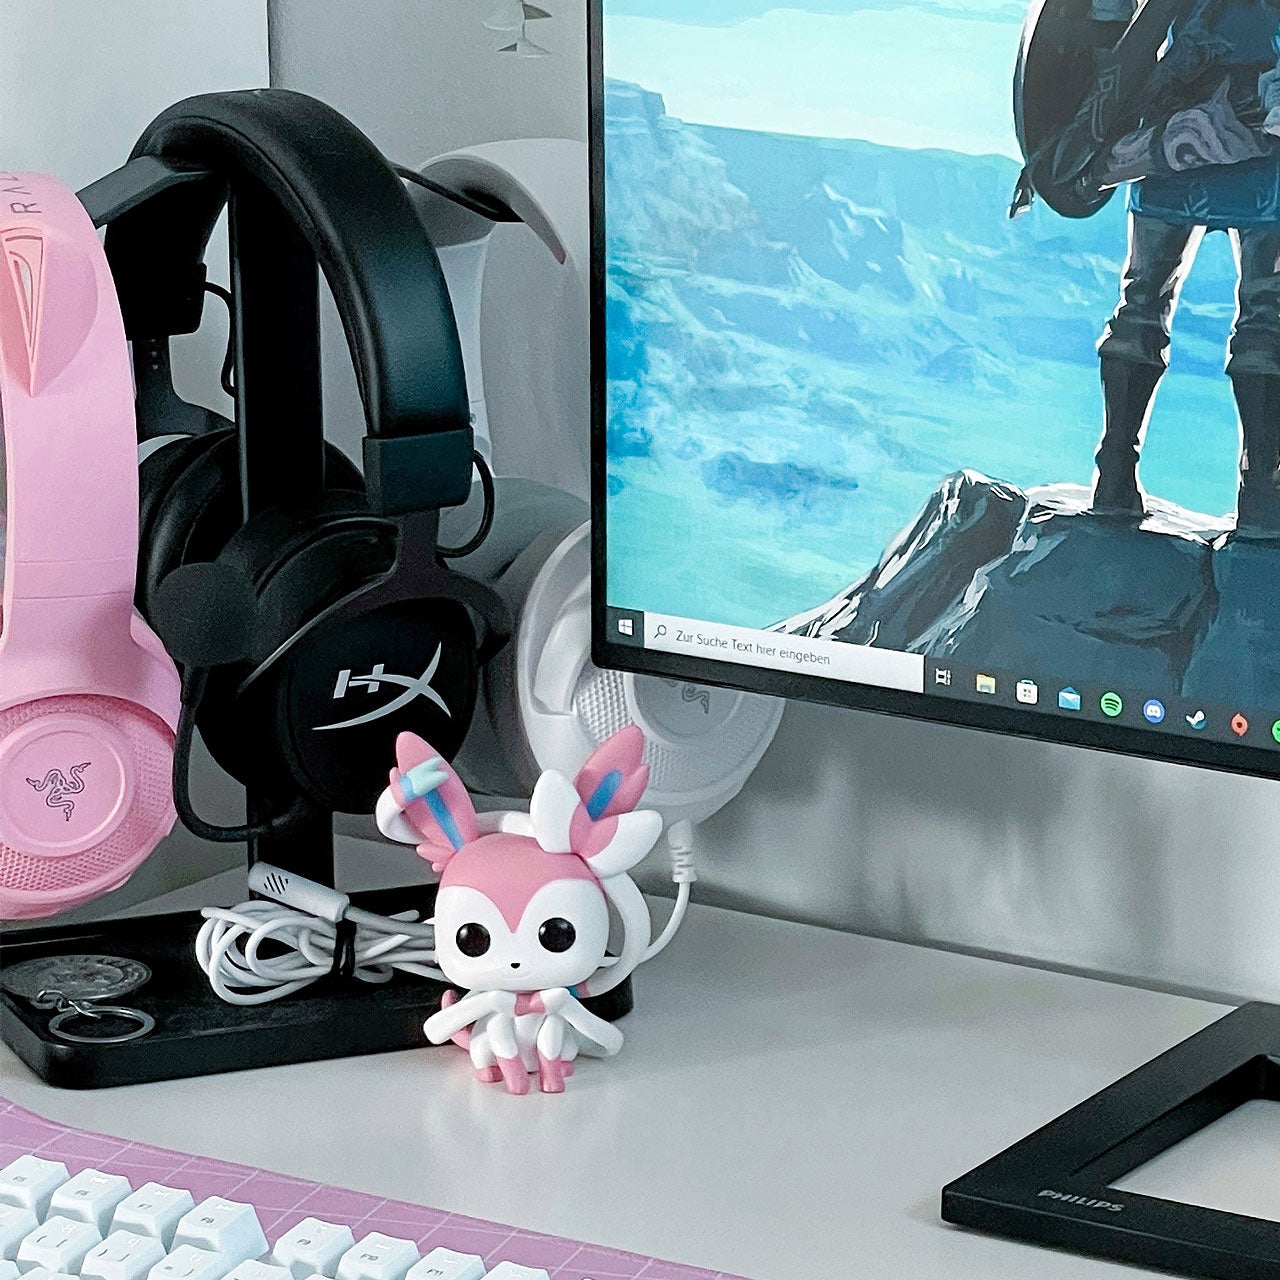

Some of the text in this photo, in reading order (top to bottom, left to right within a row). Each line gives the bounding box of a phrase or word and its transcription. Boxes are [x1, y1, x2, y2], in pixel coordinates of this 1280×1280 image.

[675, 629, 831, 665] Zur Suche Text hier eingeben
[1037, 1189, 1125, 1212] PHILIPS
